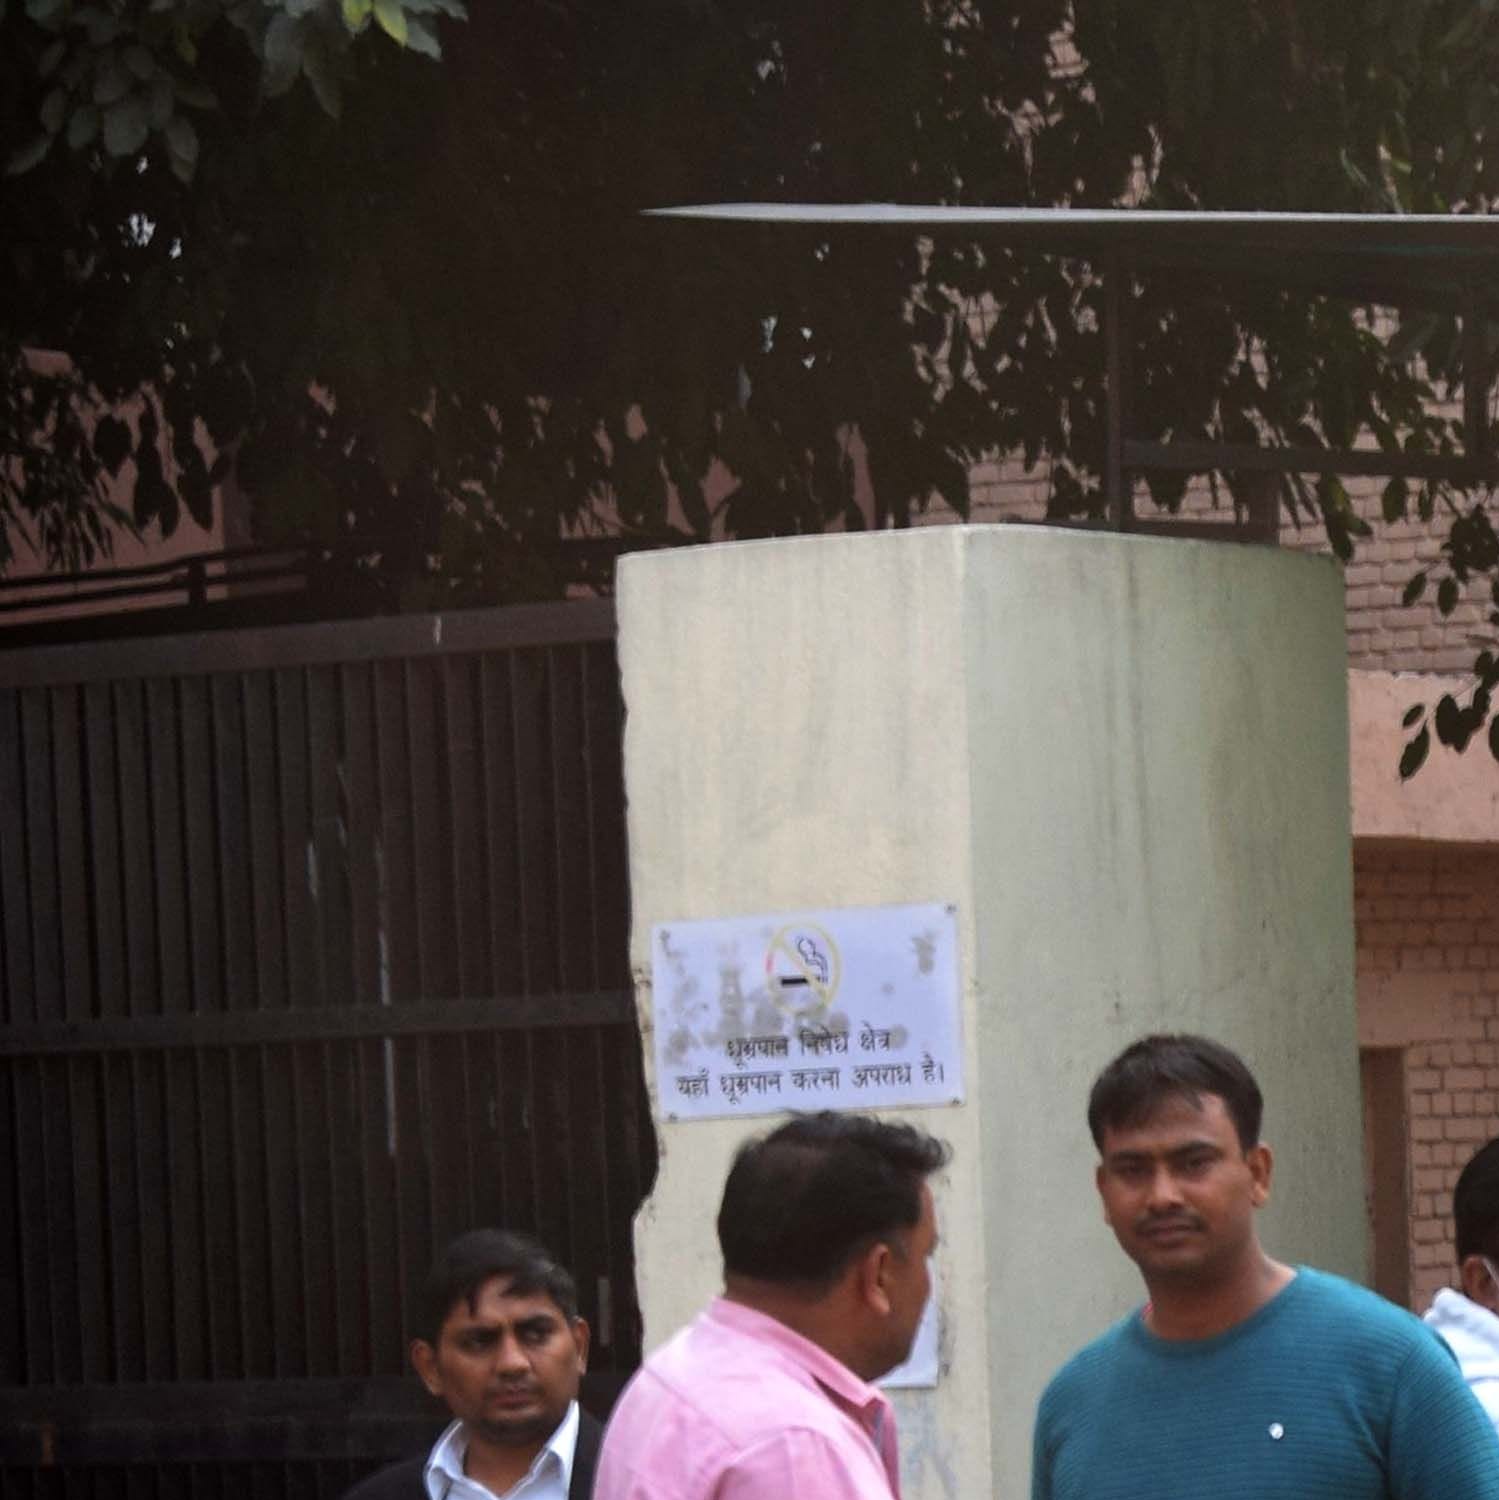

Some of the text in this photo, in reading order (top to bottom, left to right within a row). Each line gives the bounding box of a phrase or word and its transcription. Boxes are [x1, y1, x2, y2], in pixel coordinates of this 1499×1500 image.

[859, 1020, 891, 1052] क्षेत्र
[789, 1066, 841, 1091] करना
[852, 1062, 912, 1089] अपराध
